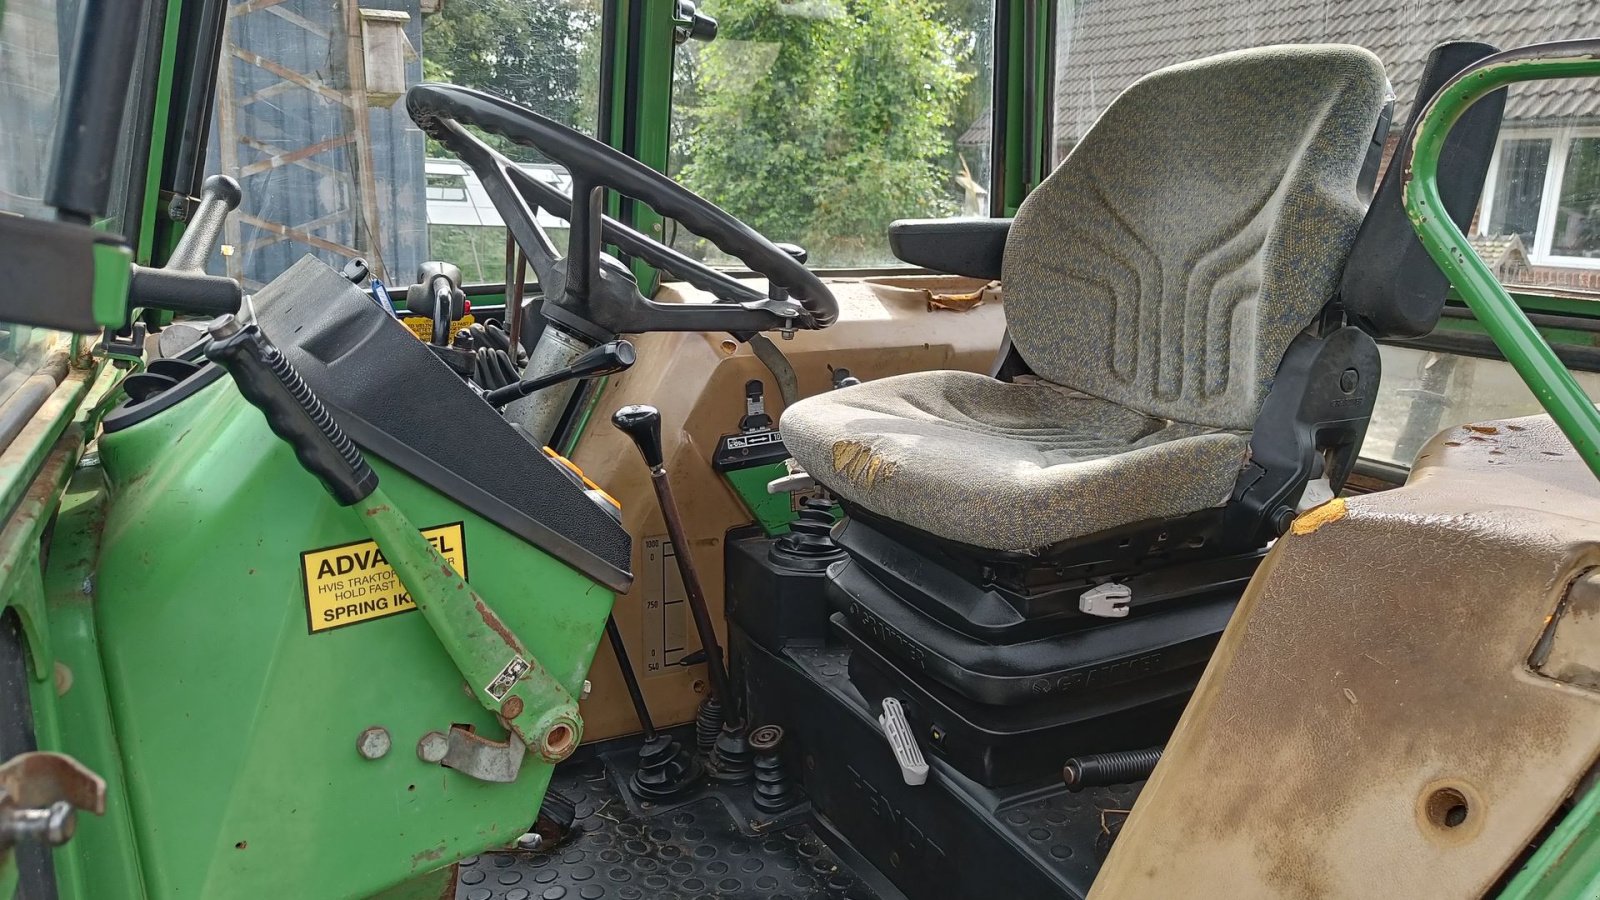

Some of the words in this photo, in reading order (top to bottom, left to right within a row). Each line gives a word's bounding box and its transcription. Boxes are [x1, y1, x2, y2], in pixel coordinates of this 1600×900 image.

[645, 539, 659, 549] 1000
[650, 553, 654, 561] 0
[318, 580, 344, 594] HVIS
[335, 588, 366, 601] HOLD
[369, 580, 396, 594] FAST
[323, 598, 388, 622] SPRING
[393, 592, 415, 607] IK
[647, 600, 659, 609] 750
[651, 649, 655, 657] 0
[648, 662, 660, 672] 540
